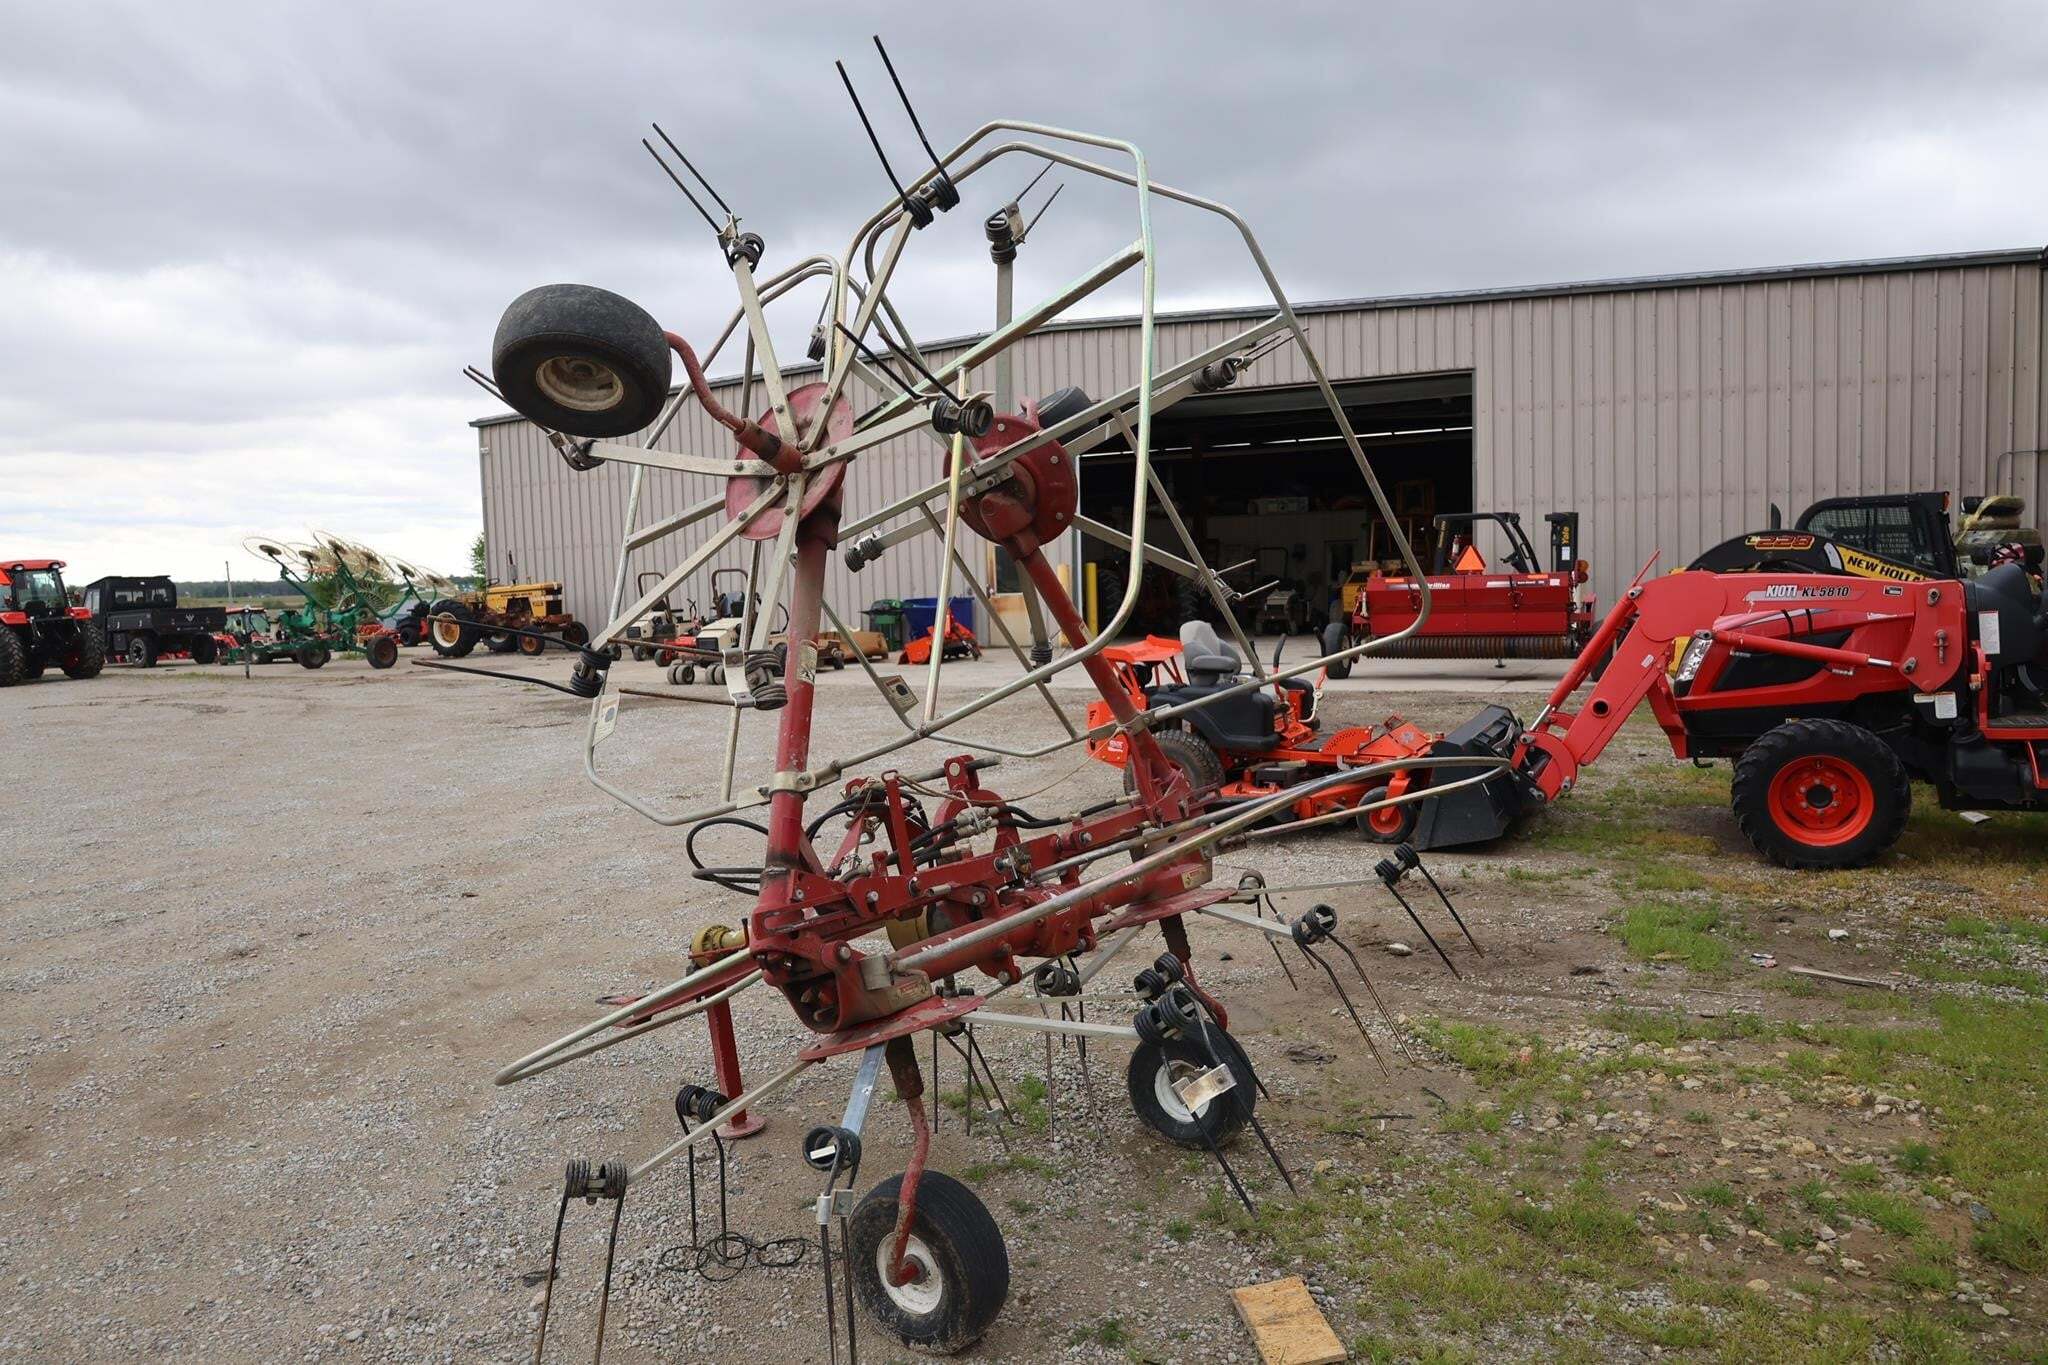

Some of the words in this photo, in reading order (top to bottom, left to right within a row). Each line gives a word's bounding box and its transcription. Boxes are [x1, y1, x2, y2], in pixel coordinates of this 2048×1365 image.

[1847, 556, 1878, 572] NEW
[1879, 566, 1926, 582] HOLL
[1766, 585, 1798, 597] KIOTI
